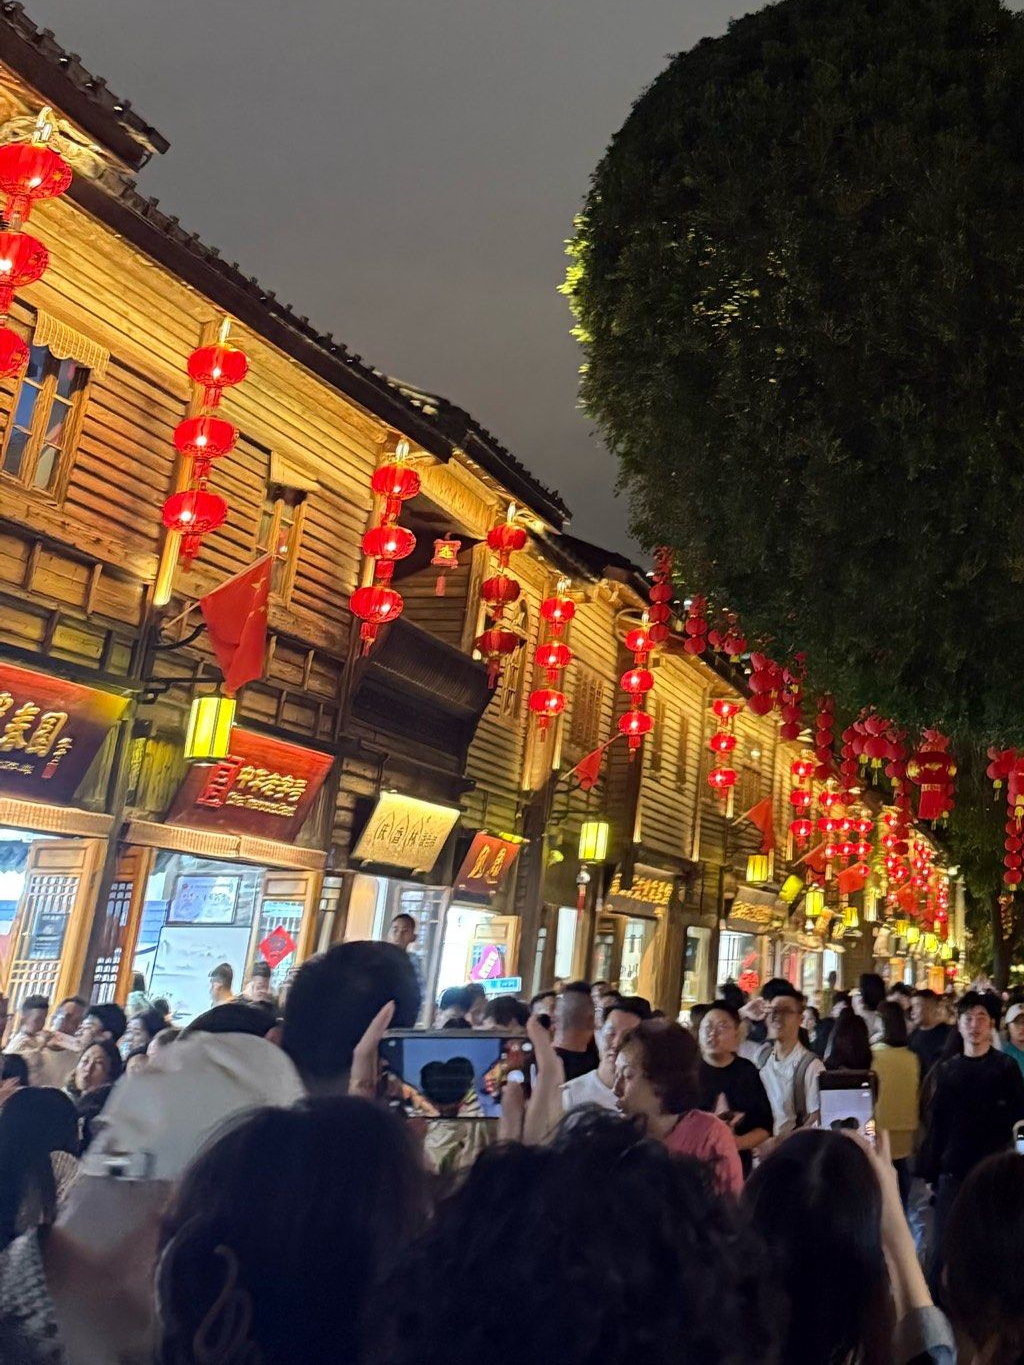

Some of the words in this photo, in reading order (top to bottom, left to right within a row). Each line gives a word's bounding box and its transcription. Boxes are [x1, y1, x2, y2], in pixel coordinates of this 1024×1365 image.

[236, 766, 308, 802] 中华老字号
